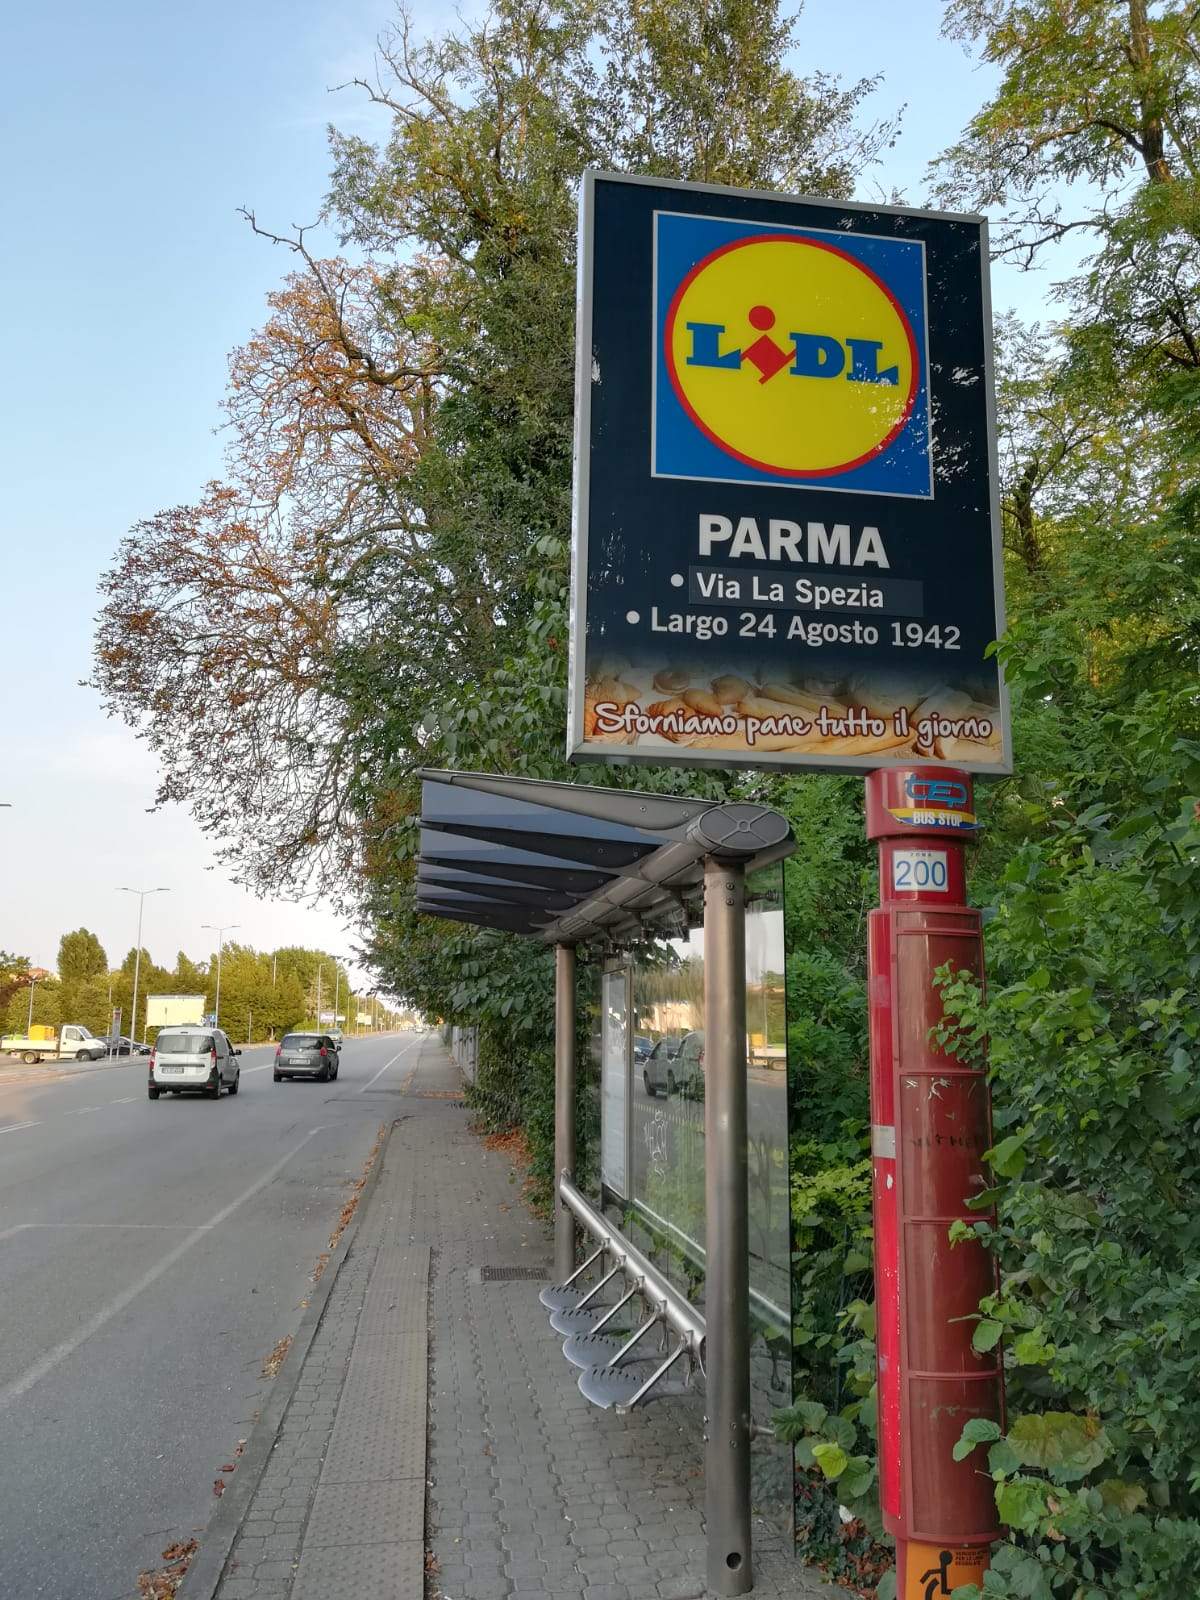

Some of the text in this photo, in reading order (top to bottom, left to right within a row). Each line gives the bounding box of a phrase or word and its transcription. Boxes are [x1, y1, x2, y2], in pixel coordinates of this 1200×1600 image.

[698, 513, 890, 569] PARMA
[696, 572, 884, 609] Via La Spezia
[651, 606, 961, 650] Largo 24 Agosto 1942
[595, 702, 994, 748] Sforniamo pane tutto il giorno
[913, 811, 962, 827] BUS STOP
[895, 860, 946, 887] 200
